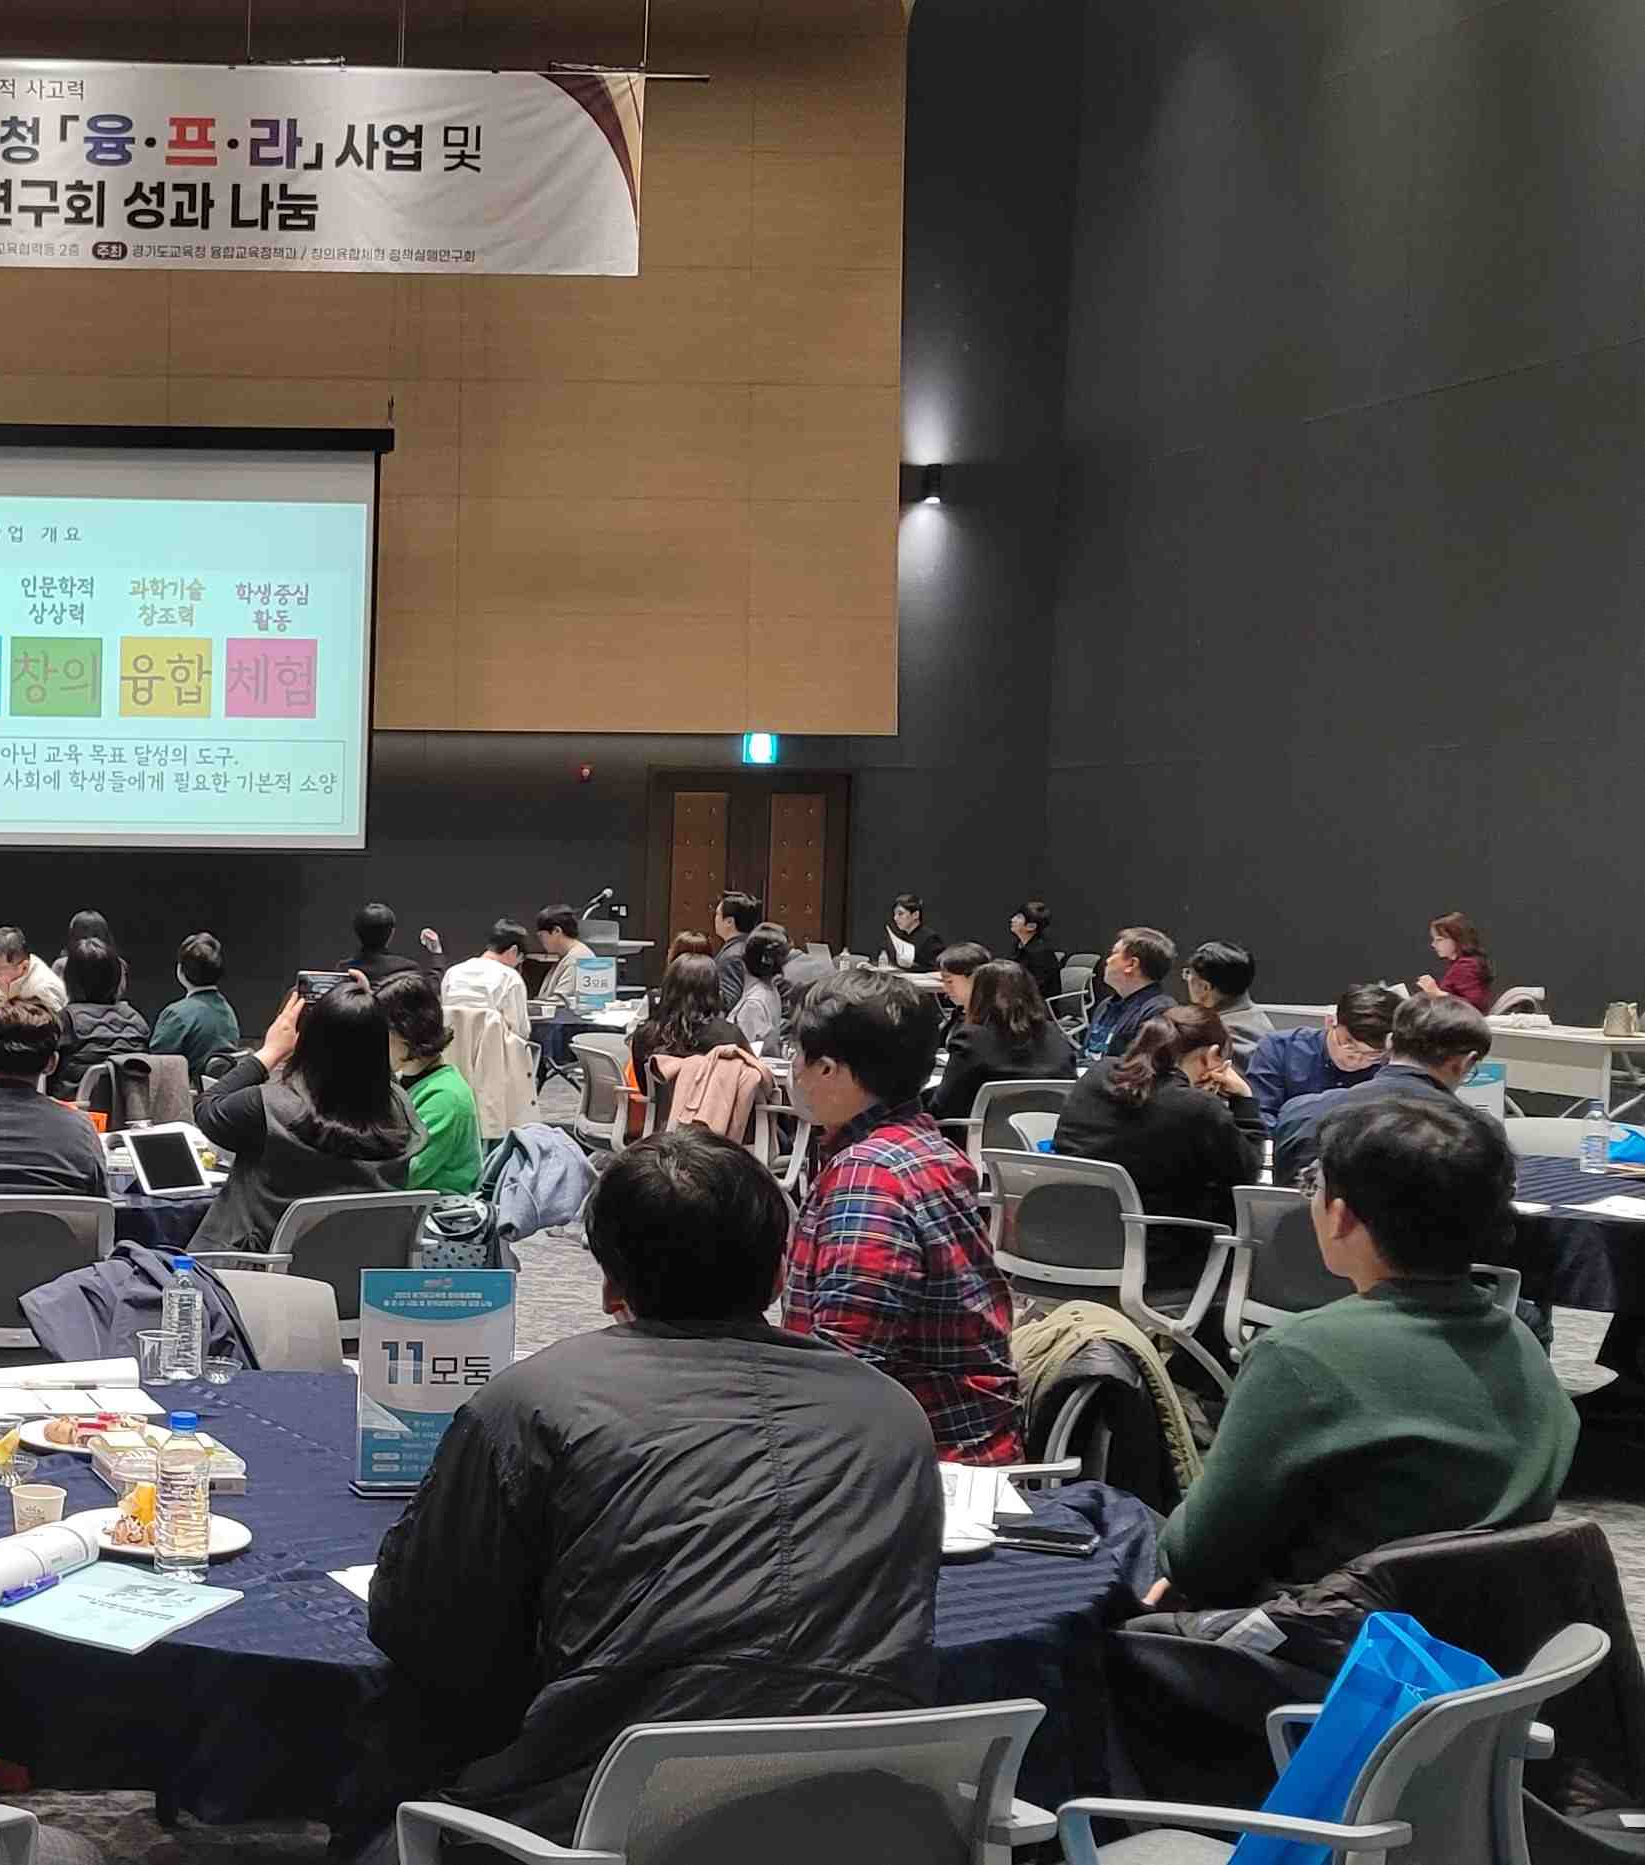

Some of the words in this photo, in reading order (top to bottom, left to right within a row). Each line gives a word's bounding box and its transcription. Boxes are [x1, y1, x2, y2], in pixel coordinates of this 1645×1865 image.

[25, 79, 85, 101] 사고력
[335, 123, 425, 172] 사업
[442, 125, 482, 173] 및
[124, 181, 215, 231] 성과
[230, 183, 319, 232] 나눔
[96, 244, 123, 258] 주최
[132, 244, 206, 259] 경기도교육청
[389, 248, 476, 263] 정책실행연구회
[41, 526, 82, 544] 개요
[20, 575, 95, 599] 인문학적
[129, 577, 206, 601] 과학기술
[235, 582, 310, 606] 학생중심
[28, 601, 85, 625] 상상력
[138, 603, 195, 627] 창조력
[253, 608, 292, 632] 활동
[11, 650, 100, 706] 창의
[121, 653, 212, 707] 융합
[227, 653, 316, 707] 체험
[0, 742, 37, 766] 아닌
[44, 744, 83, 766] 교육
[89, 745, 128, 766] 목표
[134, 745, 188, 767] 달성의
[195, 748, 239, 767] 도구.
[3, 769, 61, 792] 사회에
[68, 770, 165, 793] 학생들에게
[174, 771, 231, 793] 필요한
[237, 772, 292, 794] 기본적
[300, 773, 338, 795] 소양
[381, 1340, 492, 1386] 11모둠
